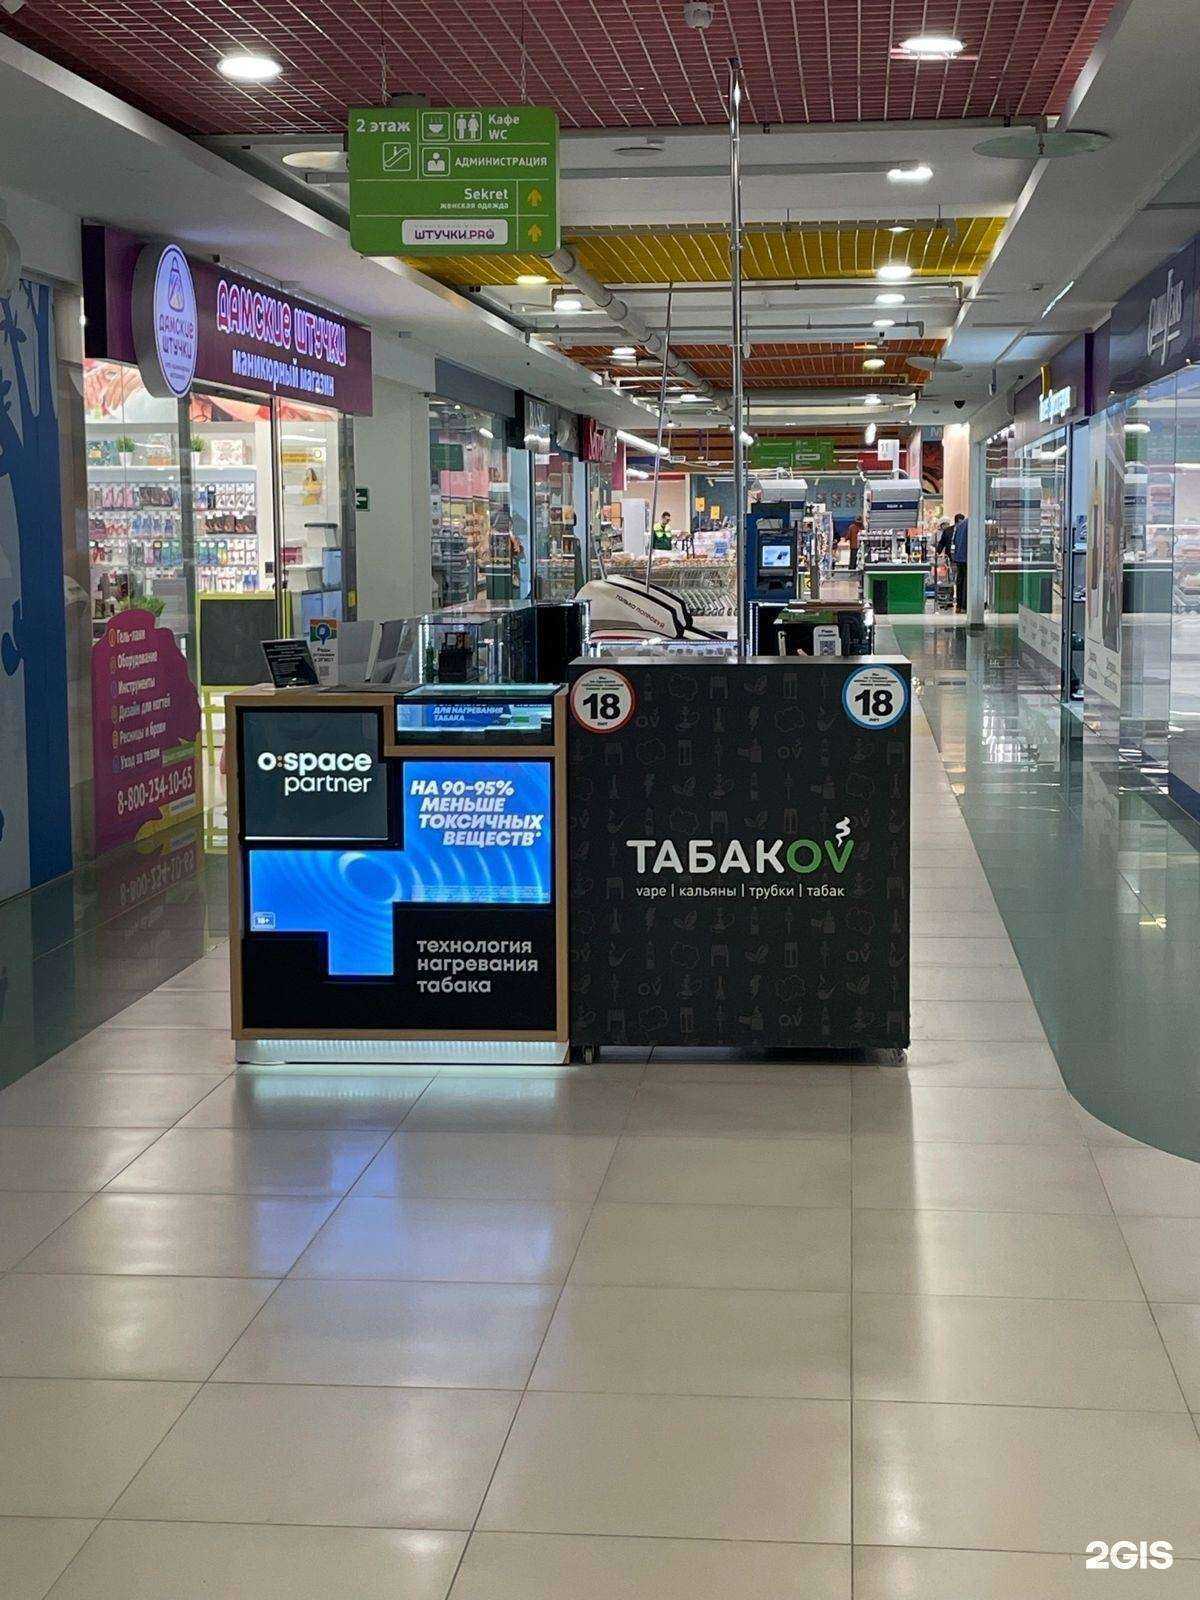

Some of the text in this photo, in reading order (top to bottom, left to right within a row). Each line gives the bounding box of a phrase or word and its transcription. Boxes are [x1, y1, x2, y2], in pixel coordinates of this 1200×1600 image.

[356, 119, 411, 133] 2 этаж
[488, 114, 520, 126] Кафе
[489, 130, 508, 140] WC
[454, 157, 548, 168] АДМИНИСТРАЦИЯ
[464, 188, 509, 200] Sekret
[440, 202, 509, 211] женская одежда
[451, 706, 504, 715] НАГРЕВАНИЯ
[582, 693, 621, 720] 18
[854, 689, 893, 717] 18
[434, 714, 465, 722] ТАБАКА
[284, 775, 372, 796] partner
[410, 780, 515, 796] НА 90-95%
[420, 797, 506, 812] МЕНЬШЕ
[419, 814, 544, 830] ТОКСИЧНЫХ
[636, 884, 845, 899] vape кальяны трубки табак
[416, 939, 532, 954] технология
[417, 957, 539, 974] нагревания
[416, 977, 491, 993] табака
